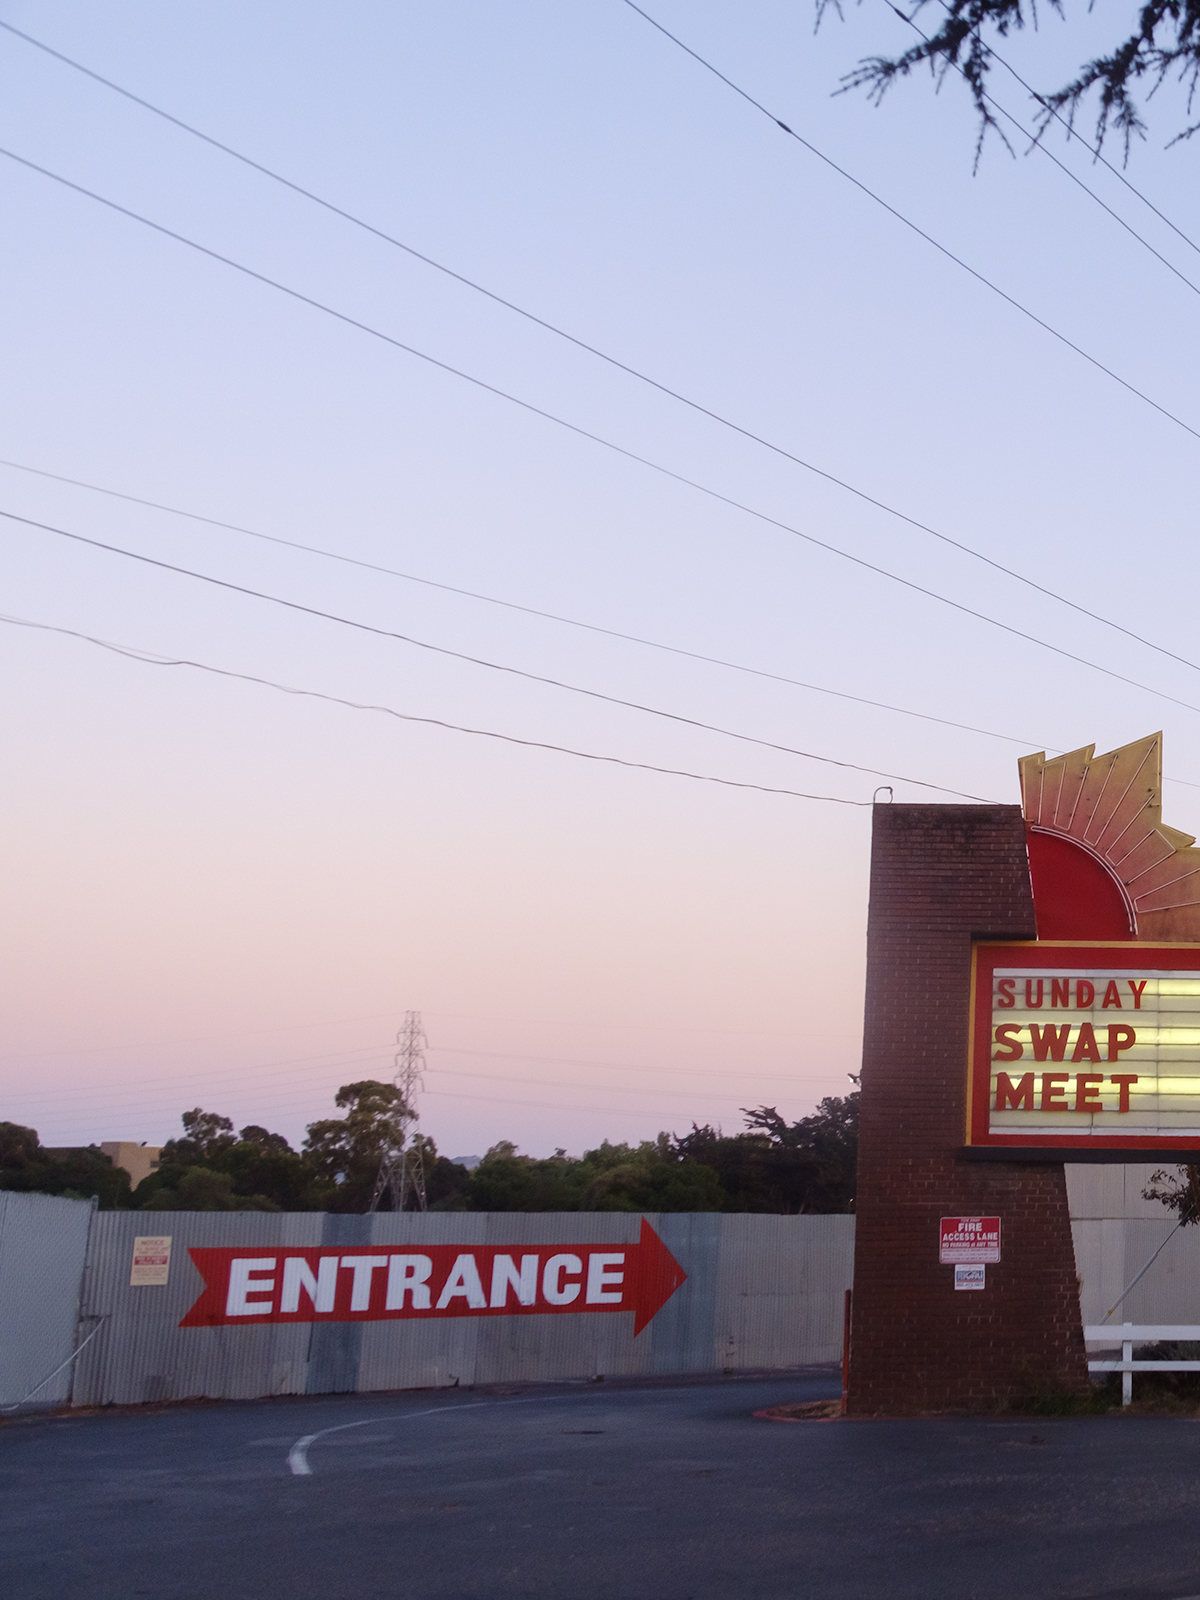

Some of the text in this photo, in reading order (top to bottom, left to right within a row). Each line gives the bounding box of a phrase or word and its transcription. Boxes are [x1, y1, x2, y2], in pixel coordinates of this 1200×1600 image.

[998, 979, 1147, 1009] SUNDAY
[994, 1022, 1136, 1063] SWAP
[995, 1072, 1138, 1113] MEET
[943, 1232, 998, 1241] ACCESS LANE
[958, 1222, 982, 1231] FIRE
[226, 1252, 626, 1317] ENTRANCE
